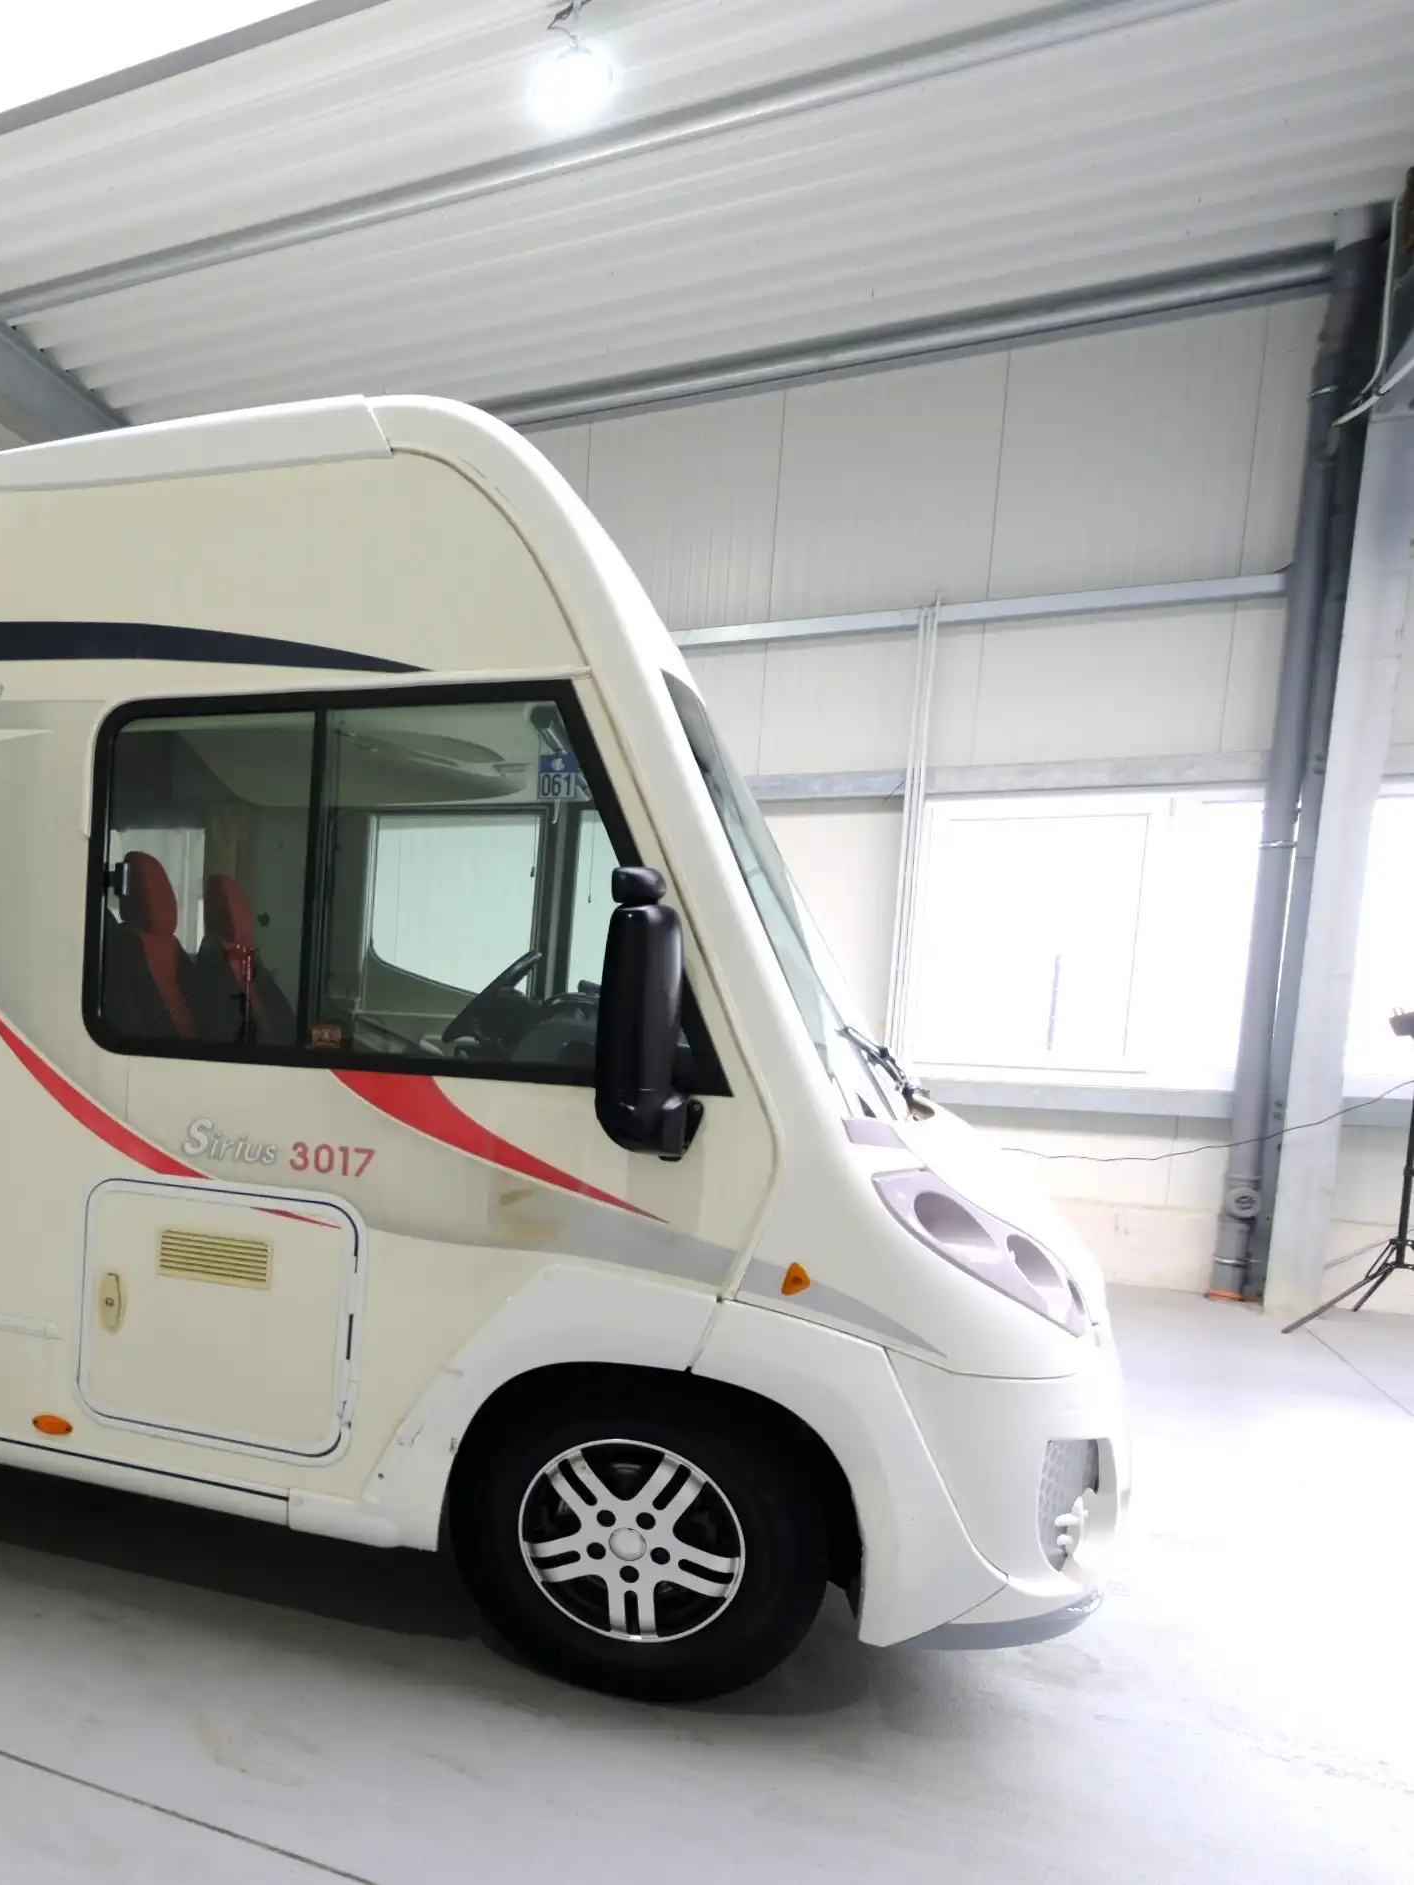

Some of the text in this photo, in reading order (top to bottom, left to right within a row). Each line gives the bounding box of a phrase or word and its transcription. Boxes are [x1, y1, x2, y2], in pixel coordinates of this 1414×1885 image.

[541, 774, 571, 797] 061
[183, 1117, 376, 1178] Sirius 3017
